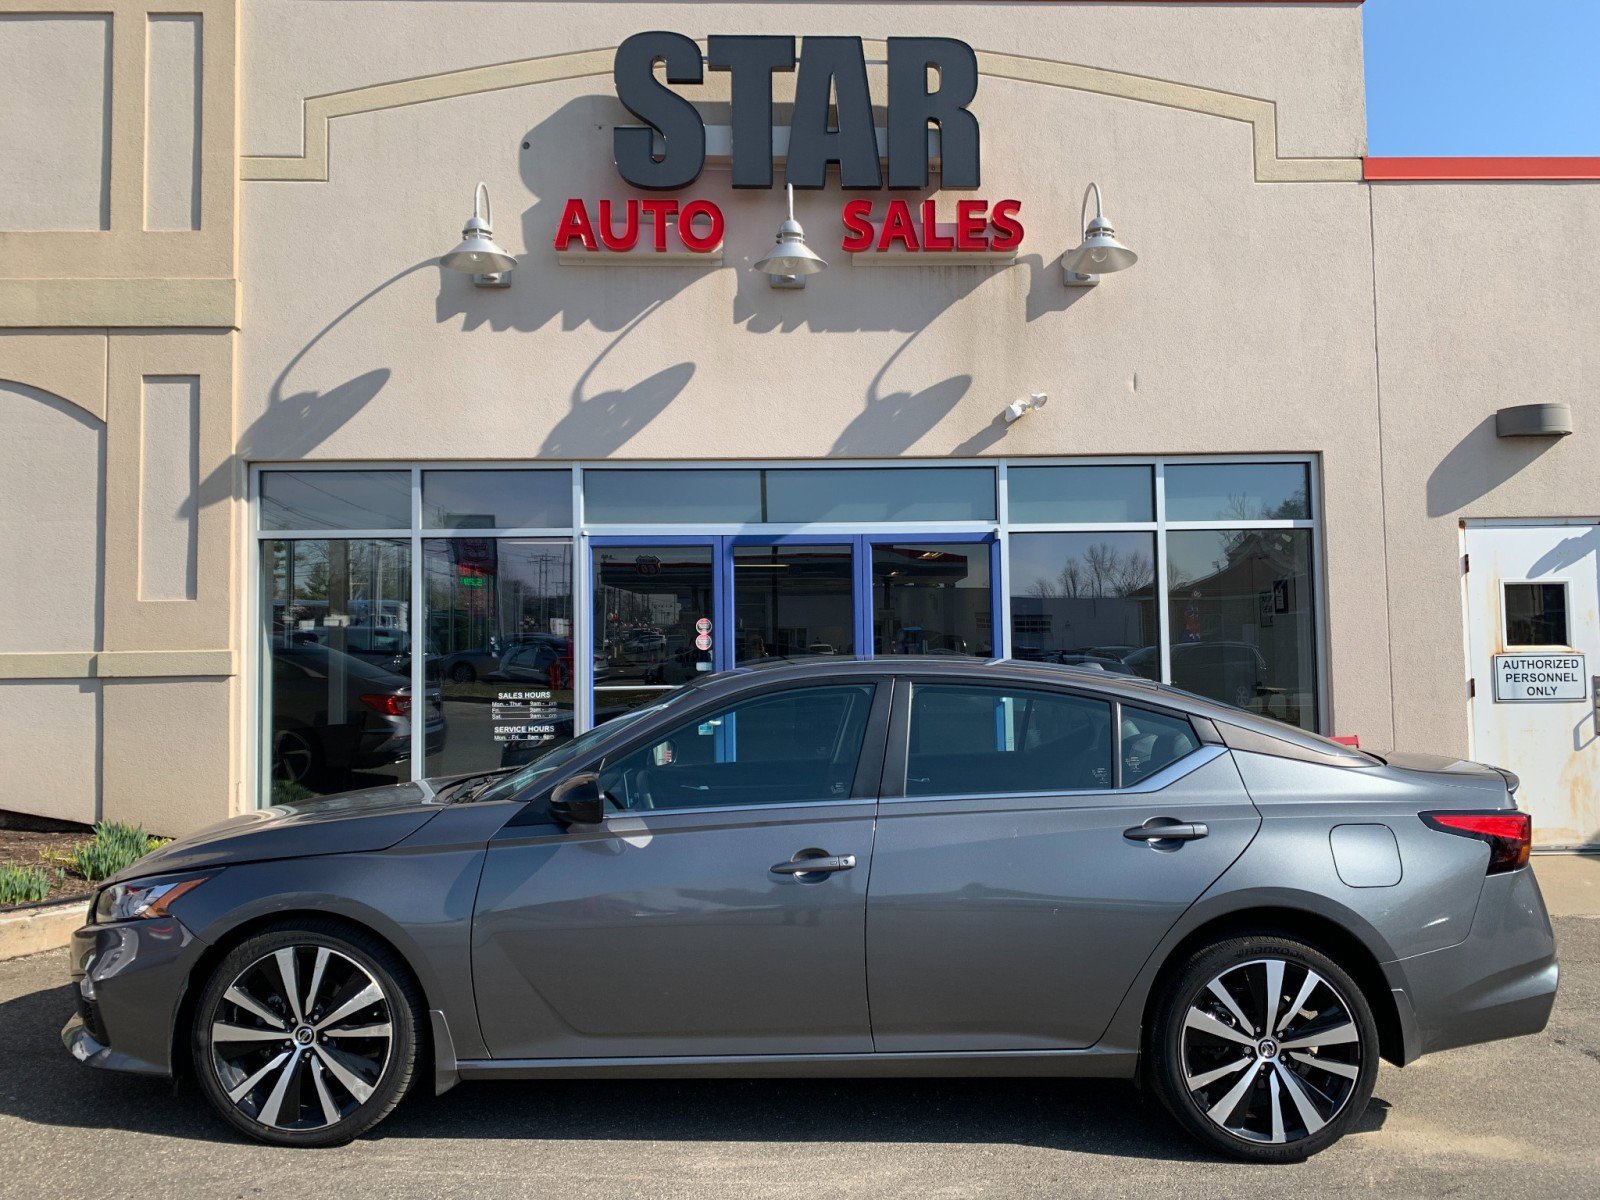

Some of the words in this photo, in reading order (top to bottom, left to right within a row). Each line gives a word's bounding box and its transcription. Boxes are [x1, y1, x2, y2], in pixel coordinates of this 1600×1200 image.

[613, 30, 981, 191] STAR
[554, 199, 725, 253] AUTO
[842, 199, 1025, 252] SALES
[1503, 659, 1579, 670] AUTHORIZED
[1505, 672, 1578, 683] PERSONNEL
[1526, 686, 1558, 696] ONLY
